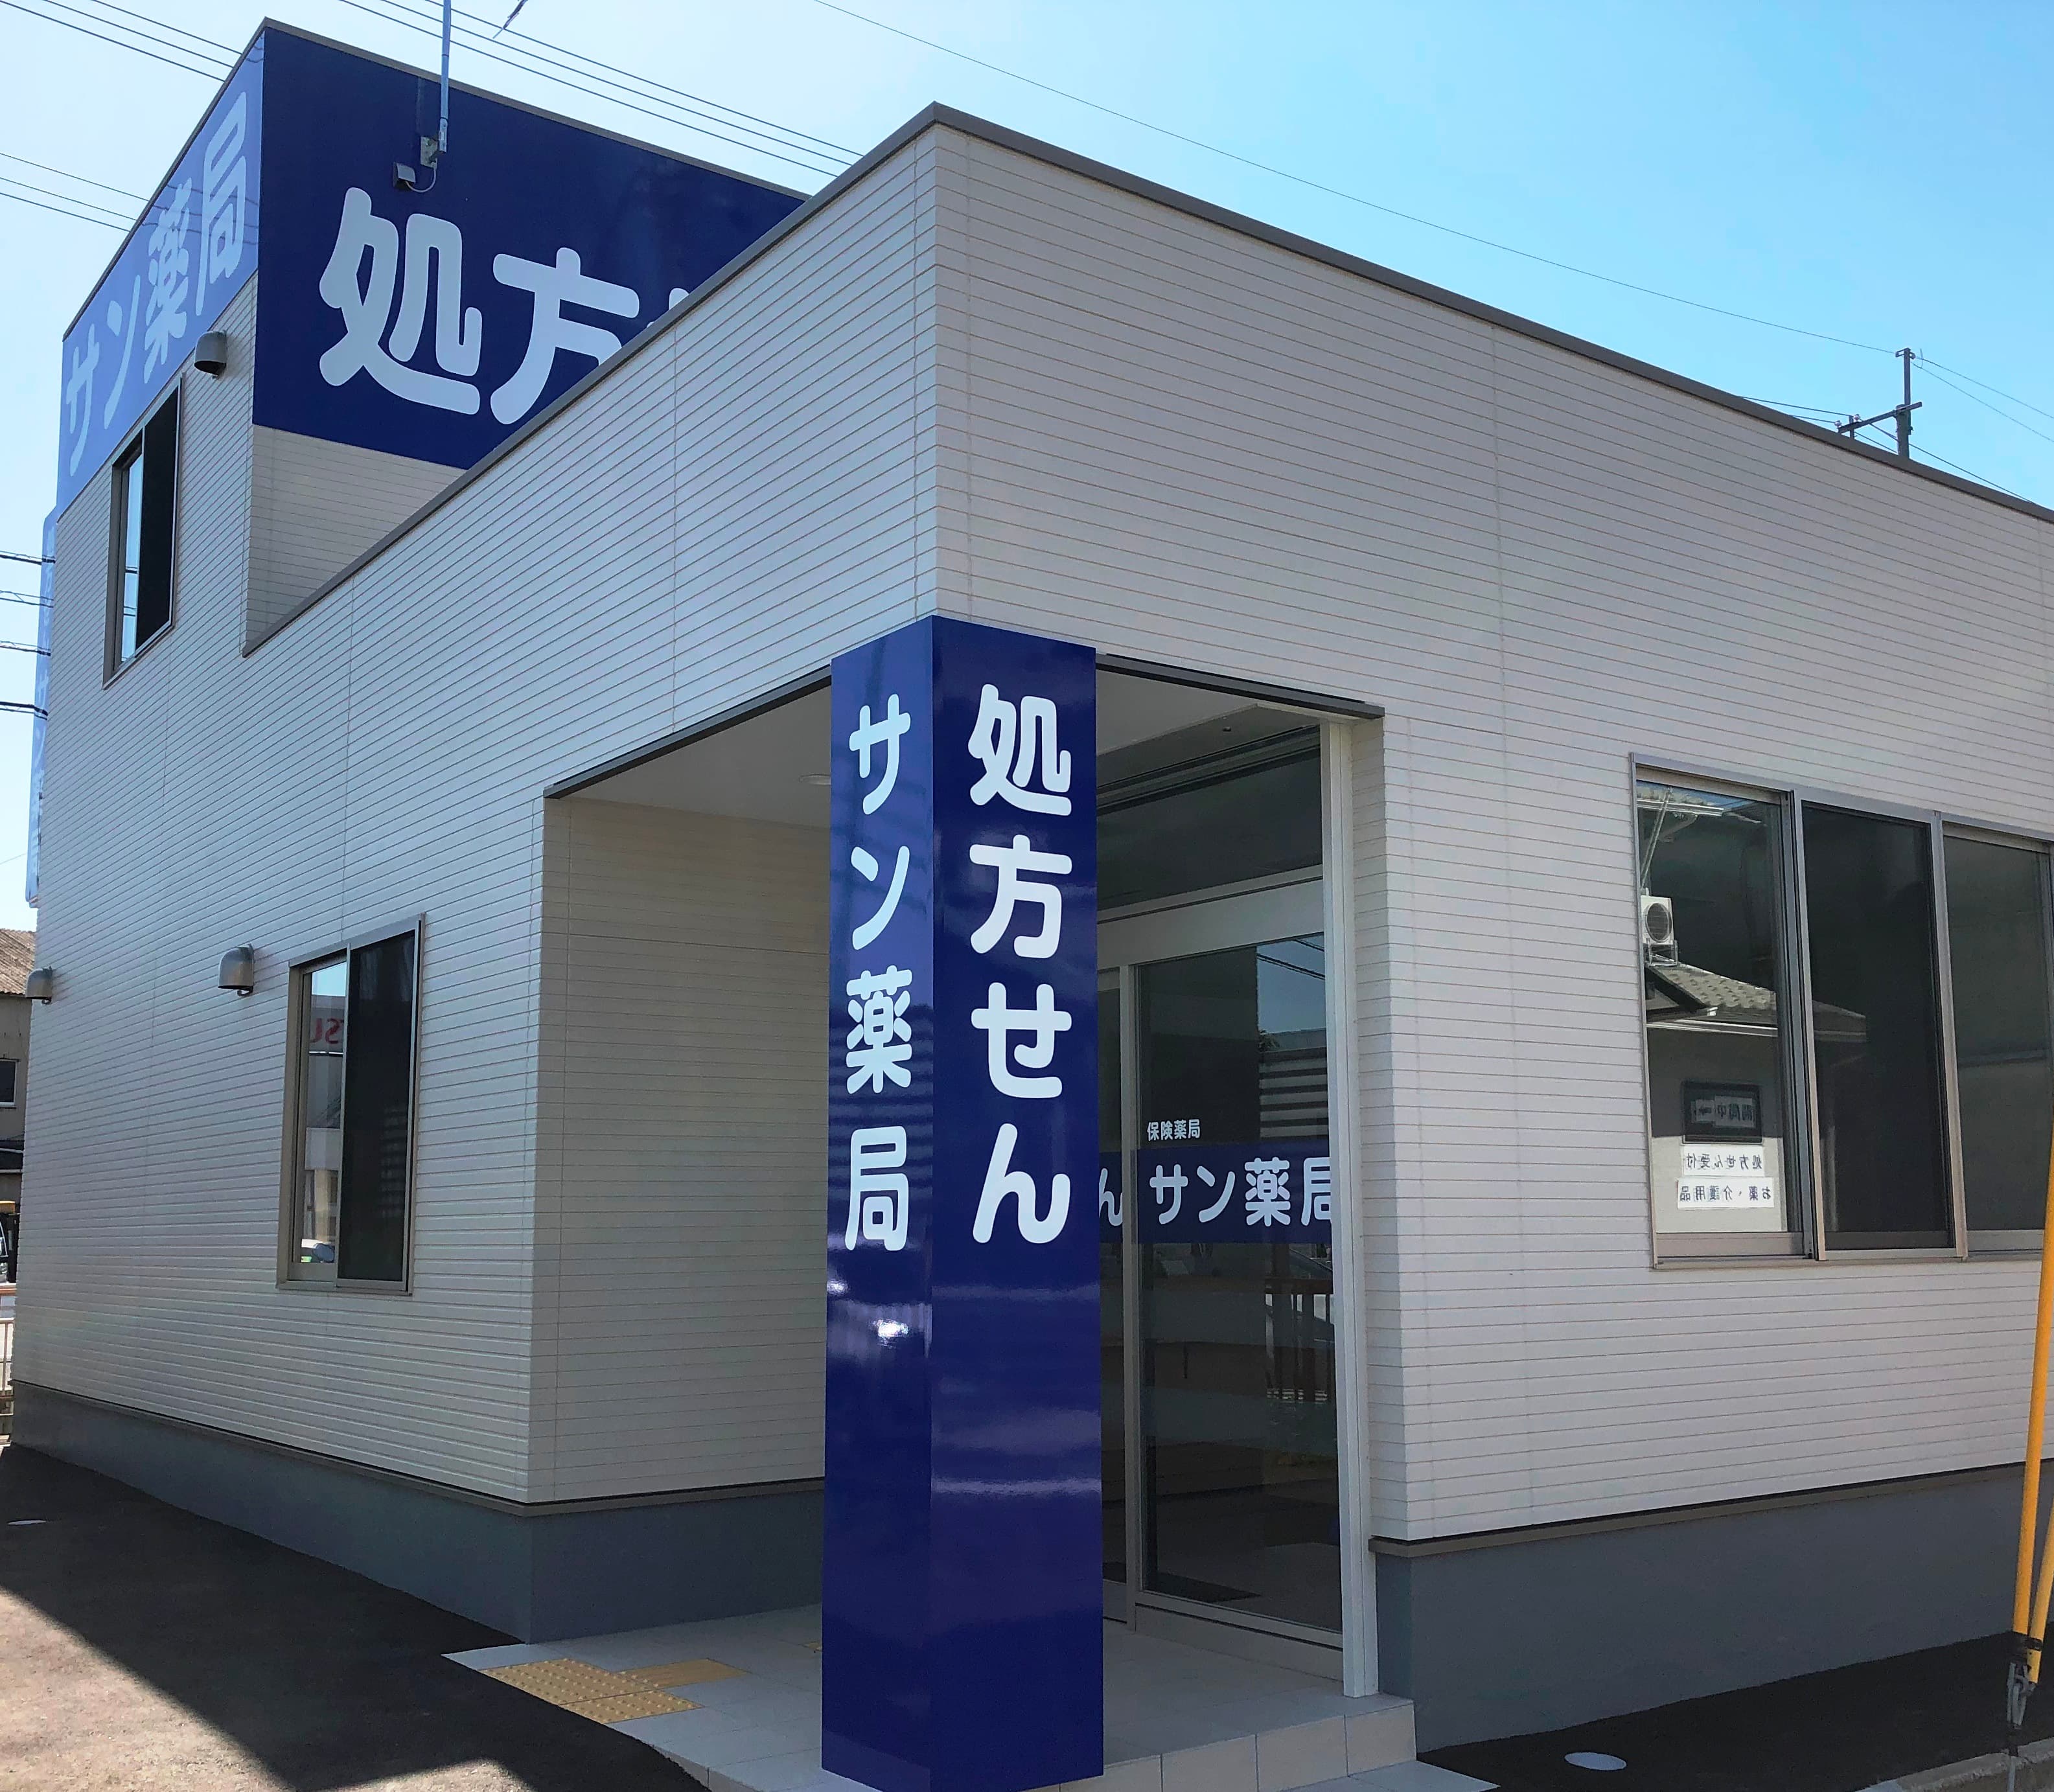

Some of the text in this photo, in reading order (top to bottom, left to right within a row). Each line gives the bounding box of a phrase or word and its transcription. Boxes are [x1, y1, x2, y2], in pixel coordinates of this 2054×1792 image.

[66, 91, 246, 476] サン薬局
[319, 187, 689, 424] 処方
[845, 694, 912, 1250] サン薬局
[968, 683, 1072, 1243] 処方せん
[1147, 1119, 1201, 1141] 保険薬局
[1149, 1156, 1332, 1226] サン薬局
